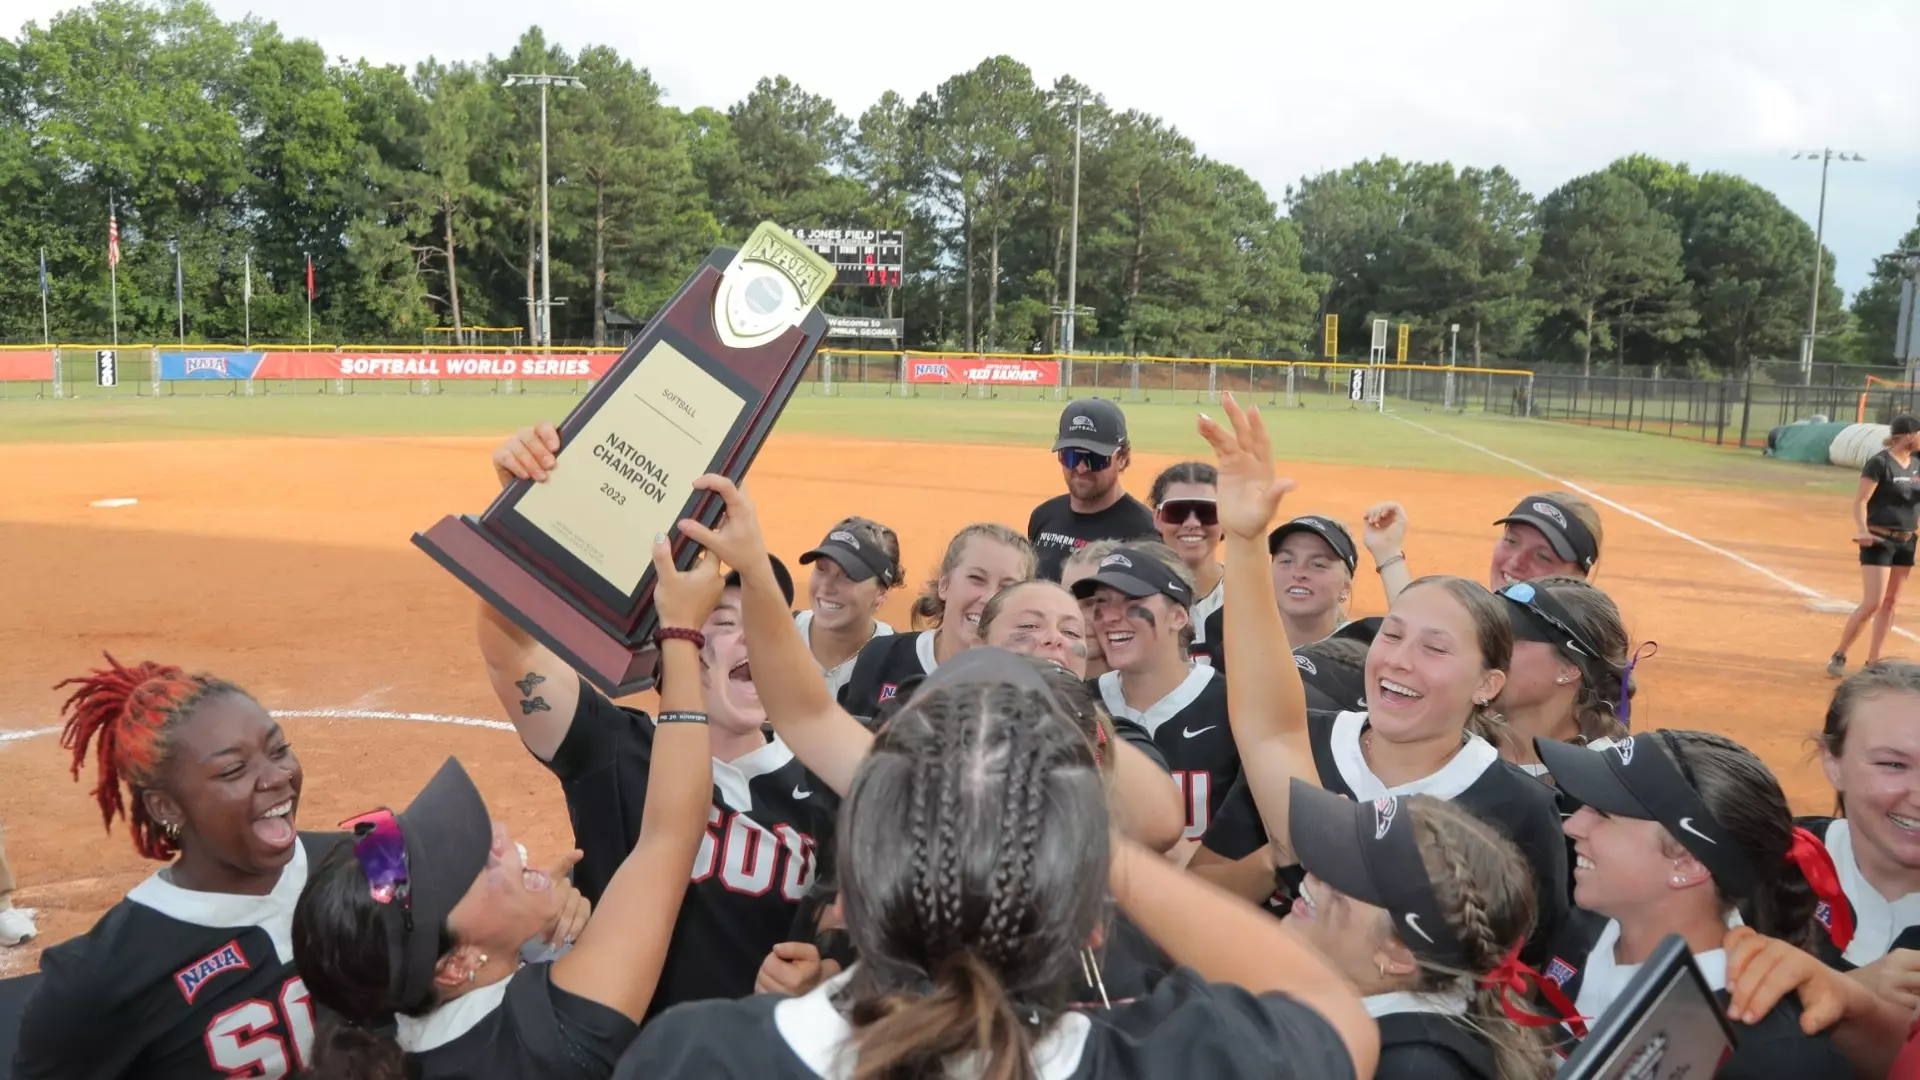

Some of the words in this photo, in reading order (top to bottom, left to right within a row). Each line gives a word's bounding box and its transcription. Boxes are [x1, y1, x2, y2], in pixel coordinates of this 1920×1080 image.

[808, 229, 842, 239] JONES
[844, 230, 875, 240] FIELD
[748, 233, 822, 299] NAIA
[828, 319, 869, 327] Welcome
[860, 328, 897, 336] GEORGIA
[101, 350, 114, 386] 220
[186, 358, 227, 373] NAIA
[340, 358, 441, 375] SOFTBALL
[446, 359, 516, 375] WORLD
[521, 359, 591, 375] SERIES
[915, 363, 947, 377] NAIA
[968, 369, 990, 380] RED
[991, 369, 1038, 381] BANNER
[1351, 369, 1363, 400] 200
[662, 388, 697, 418] SOFTBALL
[605, 432, 670, 488] NATIONAL
[593, 444, 666, 504] CHAMPION
[600, 482, 627, 506] 2023
[180, 947, 242, 994] NAIA
